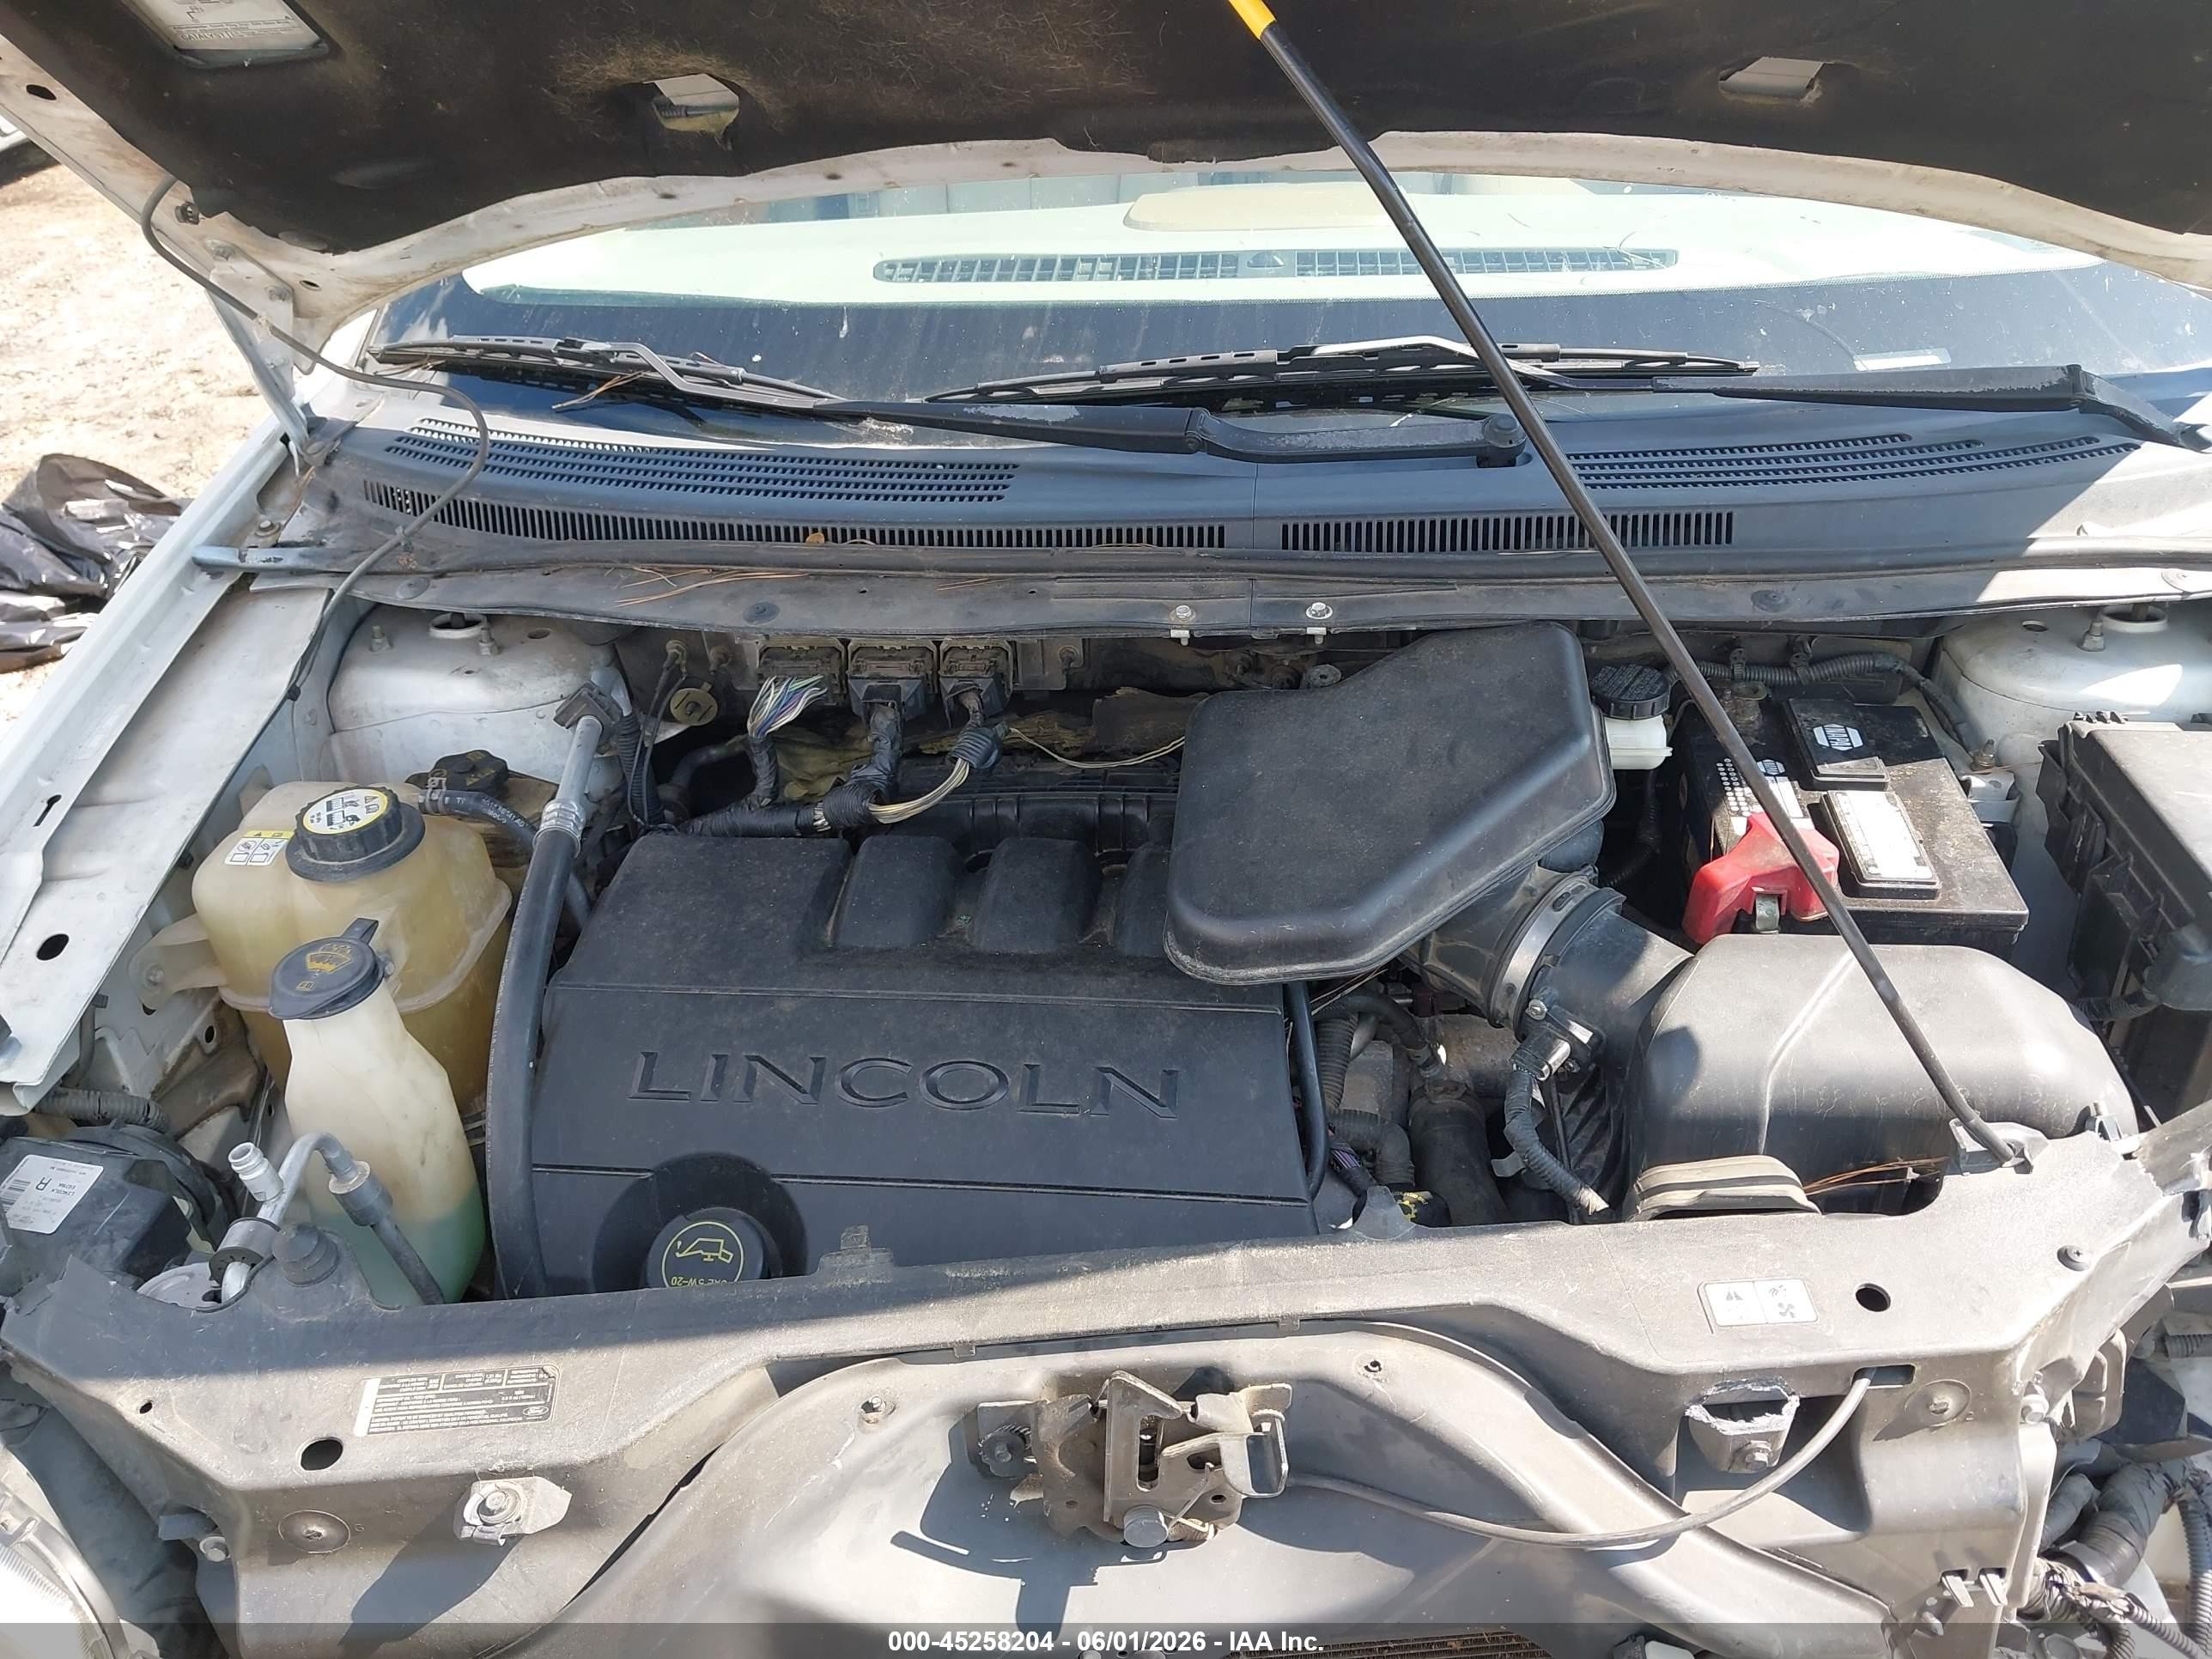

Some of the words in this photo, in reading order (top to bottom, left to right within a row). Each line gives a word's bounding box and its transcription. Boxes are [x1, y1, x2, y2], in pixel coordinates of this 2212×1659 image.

[627, 1051, 1180, 1119] LINCOLN
[35, 1176, 52, 1192] R
[671, 1276, 705, 1286] 5W-20
